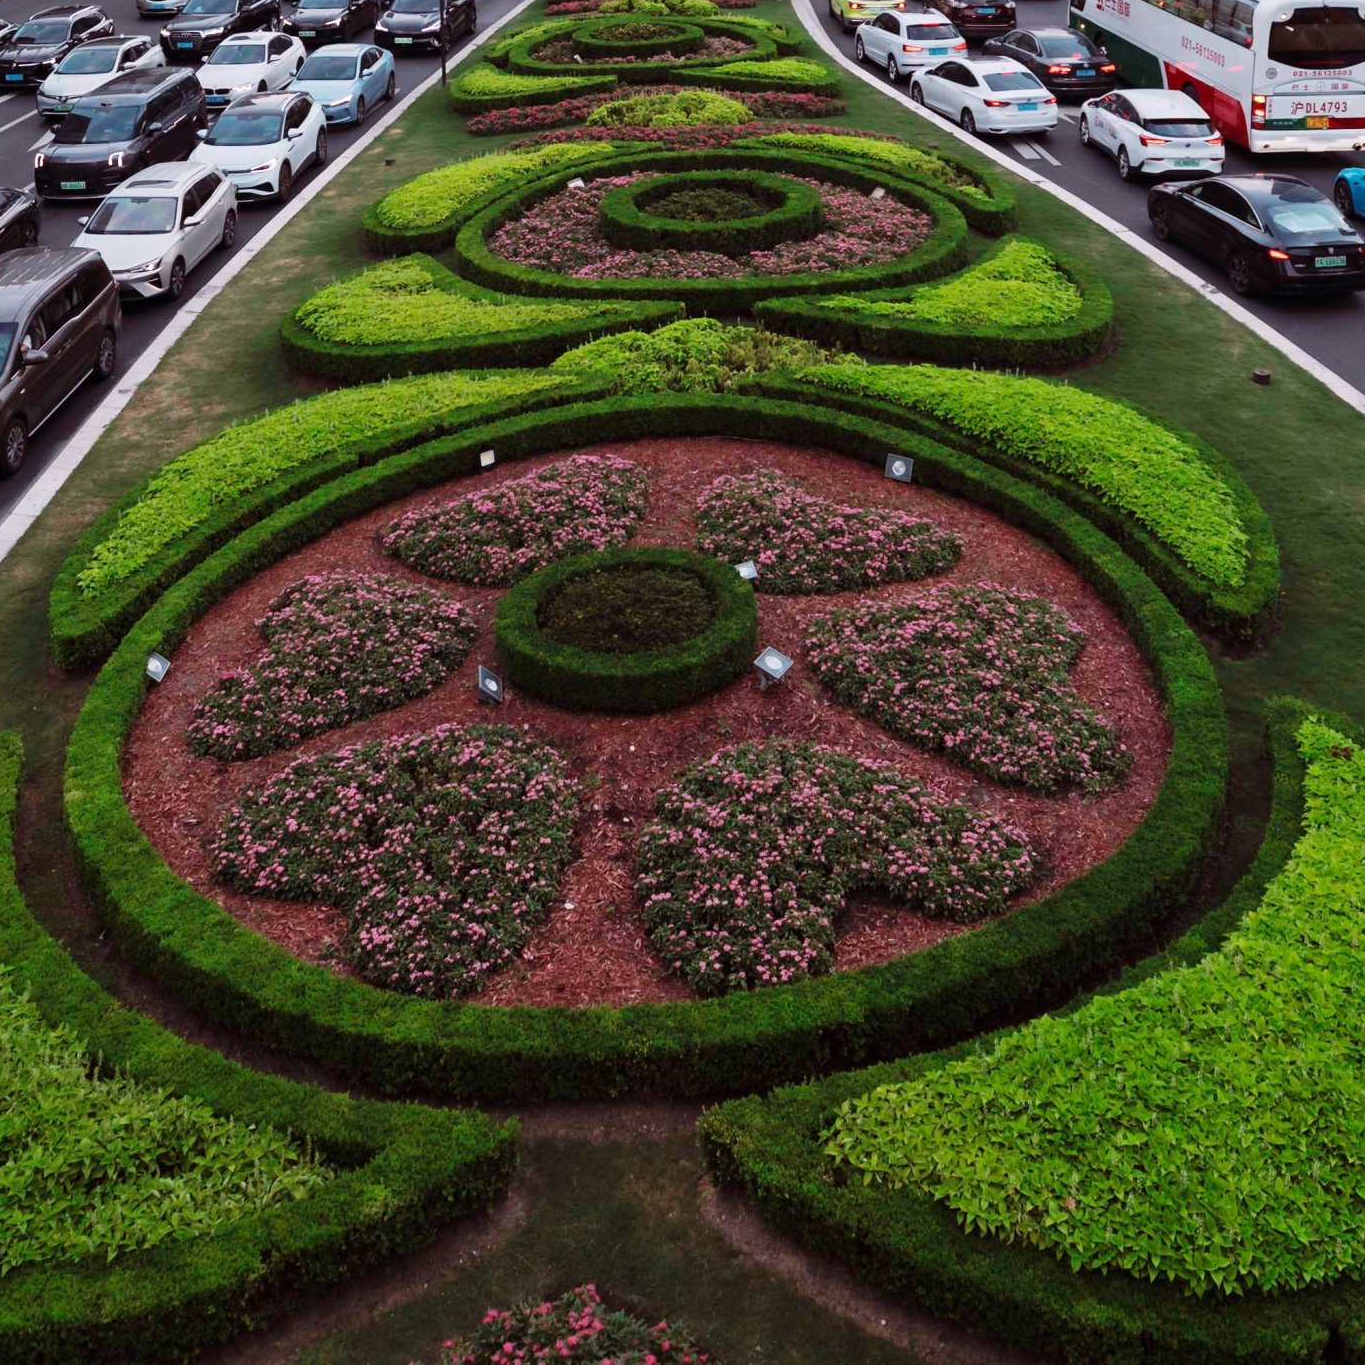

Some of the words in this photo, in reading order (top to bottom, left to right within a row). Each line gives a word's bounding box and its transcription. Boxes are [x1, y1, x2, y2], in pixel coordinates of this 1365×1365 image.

[1181, 36, 1226, 67] 021-56135003
[1292, 69, 1353, 77] 021-56135003
[1290, 101, 1348, 116] 沪DL4793
